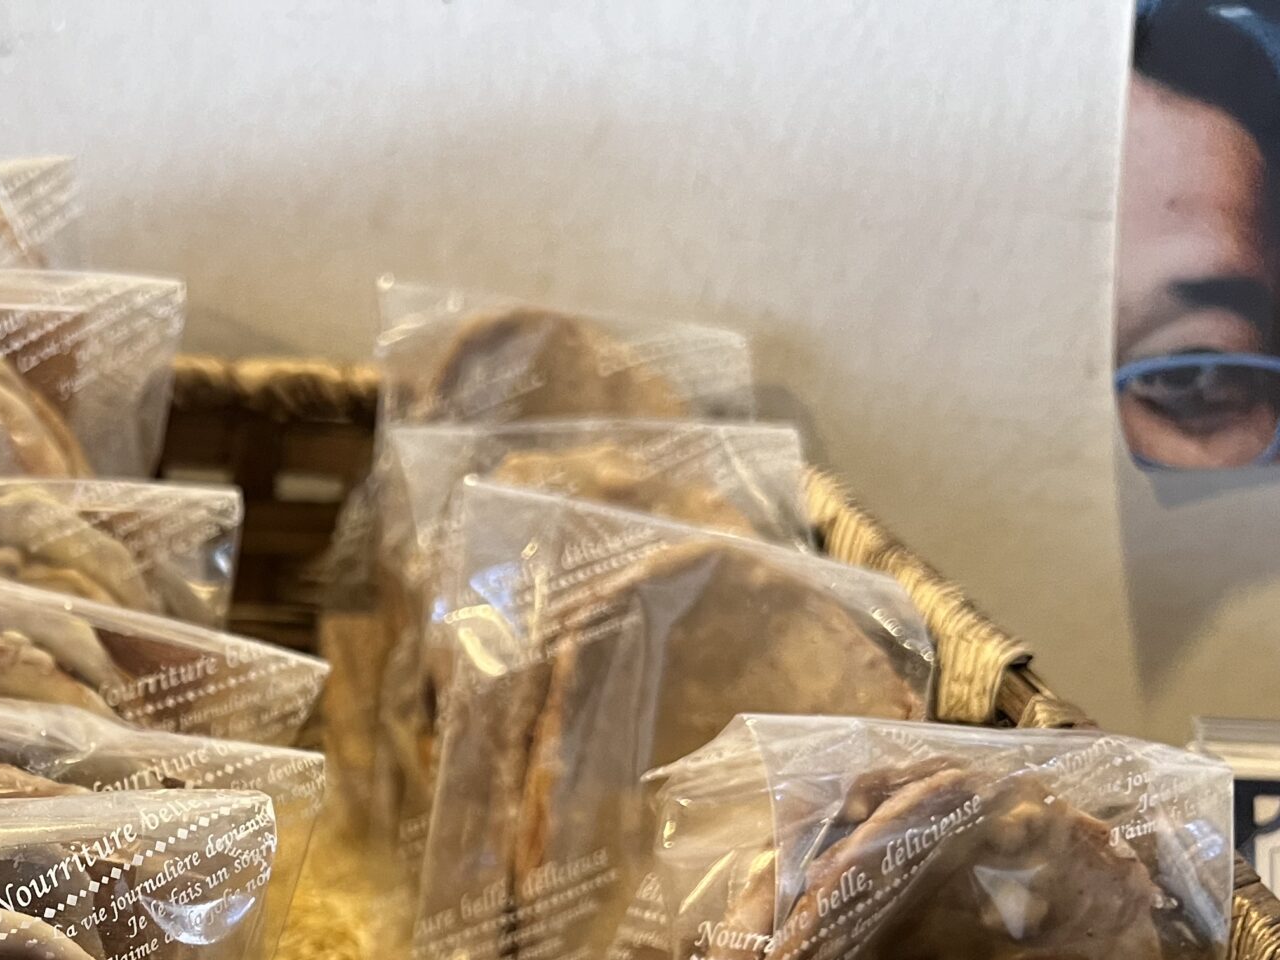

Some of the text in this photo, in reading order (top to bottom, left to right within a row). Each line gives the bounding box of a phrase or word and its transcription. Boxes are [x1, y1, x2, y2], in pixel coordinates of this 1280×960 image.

[53, 923, 77, 940] La
[81, 905, 107, 931] vie
[111, 850, 201, 923] journalière
[816, 866, 874, 918] belle,
[880, 793, 982, 875] délicieuse
[127, 914, 148, 939] Je
[169, 882, 203, 915] fais
[206, 867, 231, 890] un
